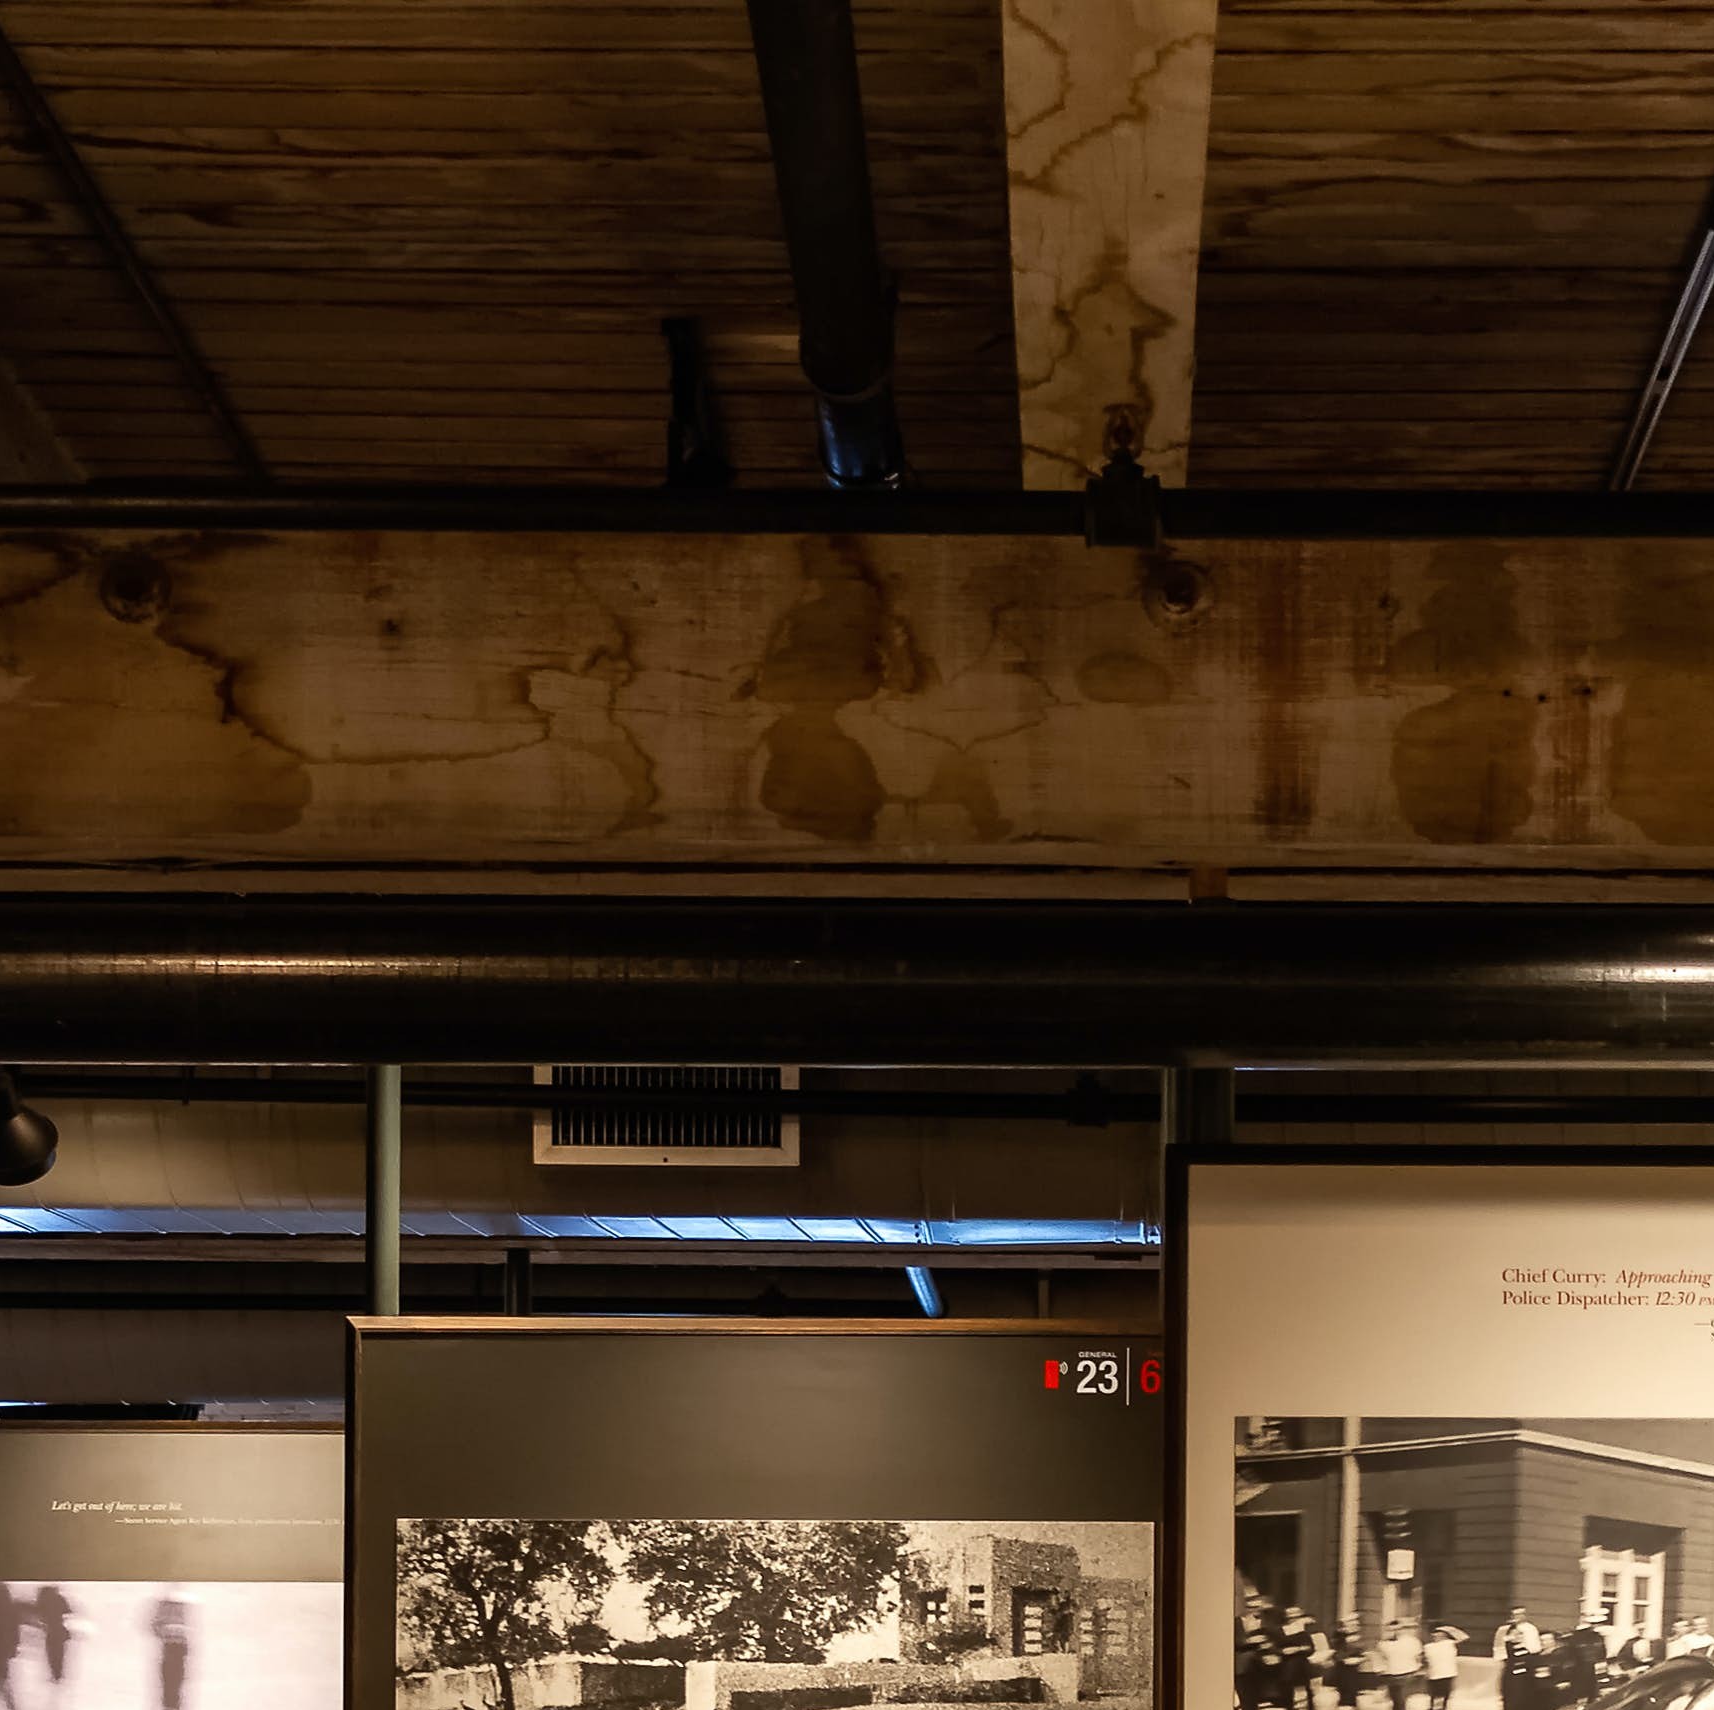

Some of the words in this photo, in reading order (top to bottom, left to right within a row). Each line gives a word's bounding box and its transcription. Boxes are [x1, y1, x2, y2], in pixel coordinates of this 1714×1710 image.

[1501, 1268, 1549, 1284] Chief
[1552, 1268, 1607, 1288] Curry:
[1615, 1268, 1713, 1289] Approaching
[1502, 1290, 1551, 1306] Police
[1557, 1290, 1650, 1309] Dispatcher:
[1655, 1291, 1696, 1306] 12:30
[1078, 1350, 1118, 1359] GENERAL
[1076, 1360, 1119, 1394] 23
[1140, 1359, 1162, 1394] 6
